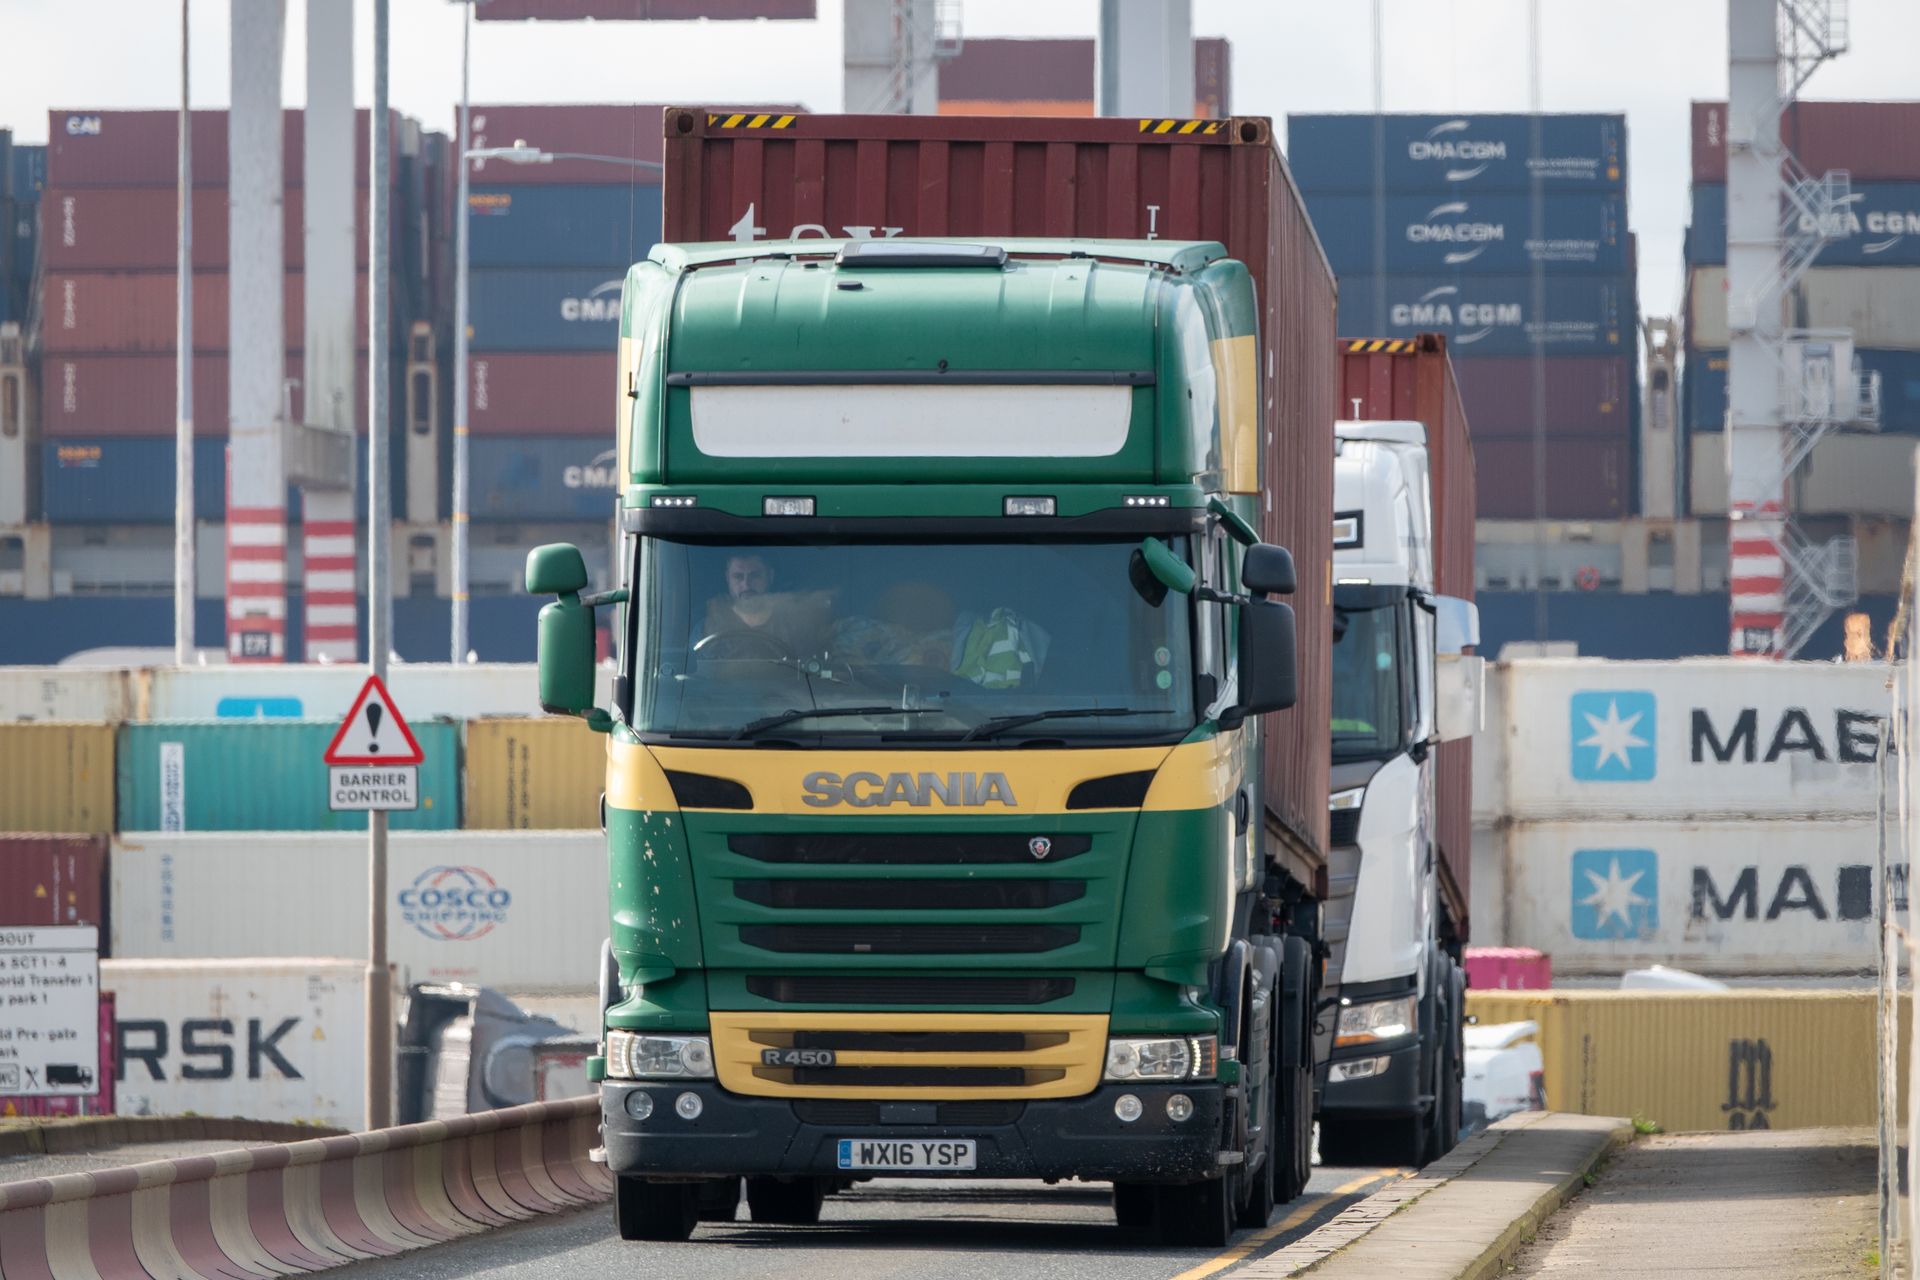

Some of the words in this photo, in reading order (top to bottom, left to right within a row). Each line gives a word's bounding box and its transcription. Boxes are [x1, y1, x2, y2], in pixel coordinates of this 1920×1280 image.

[1408, 141, 1454, 160] CMA
[1456, 141, 1507, 160] CGM
[1406, 223, 1454, 242] CMA
[1455, 222, 1505, 242] CGM
[1390, 303, 1453, 326] CMA
[1458, 303, 1522, 326] CGM
[1691, 708, 1908, 763] MAE
[340, 772, 407, 787] BARRIER
[801, 771, 1018, 808] SCANIA
[335, 788, 412, 804] CONTROL
[398, 888, 512, 909] COSCO
[402, 909, 508, 924] SHIPPING
[9, 995, 38, 1007] park
[116, 1017, 304, 1081] RSK
[765, 1050, 781, 1065] R
[784, 1051, 833, 1065] 450
[860, 1143, 914, 1165] WX16
[921, 1143, 968, 1165] YSP
